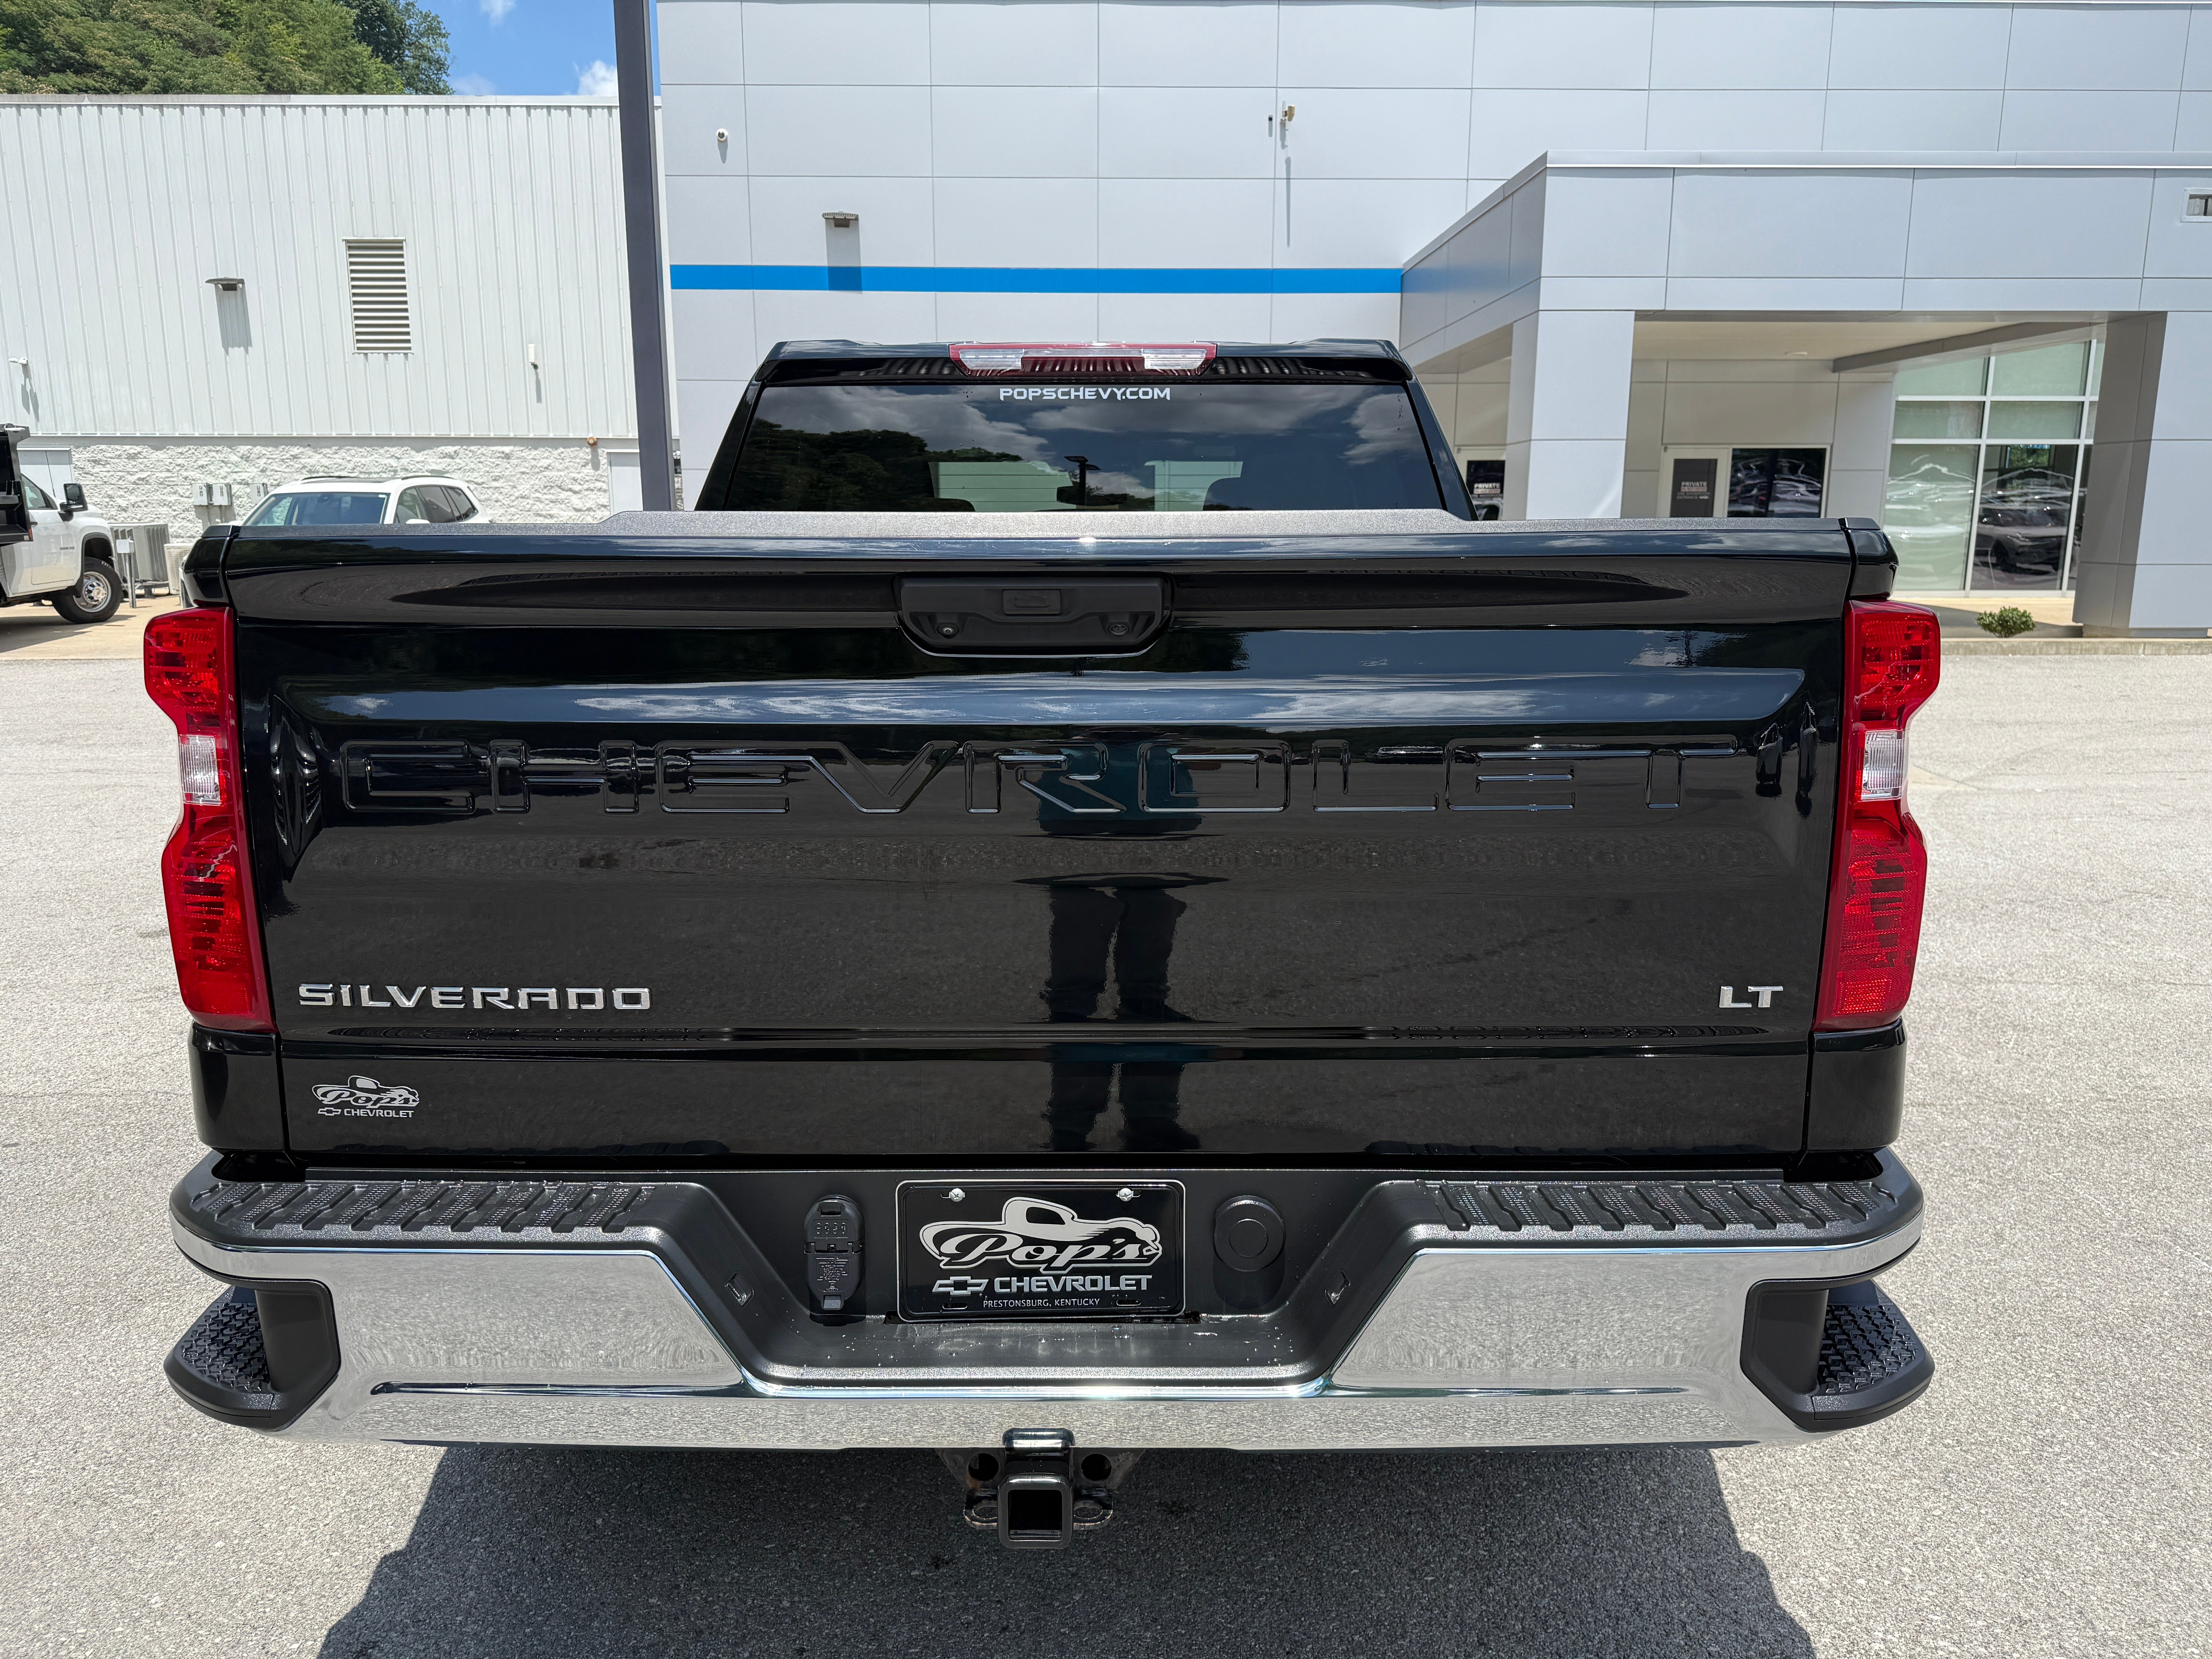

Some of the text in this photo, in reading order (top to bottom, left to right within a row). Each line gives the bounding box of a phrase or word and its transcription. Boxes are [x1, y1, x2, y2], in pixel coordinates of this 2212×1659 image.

[1000, 386, 1170, 401] POPSCHEVY.COM
[339, 734, 1738, 814] CHEVROLET
[299, 984, 651, 1010] SILVERADO
[1719, 986, 1783, 1008] LT
[344, 1108, 414, 1118] CHEVROLET
[940, 1233, 1147, 1267] Pop's
[994, 1275, 1152, 1293] CHEVROLET
[983, 1298, 1100, 1308] PRESTONSBURG, KENTUCKY
